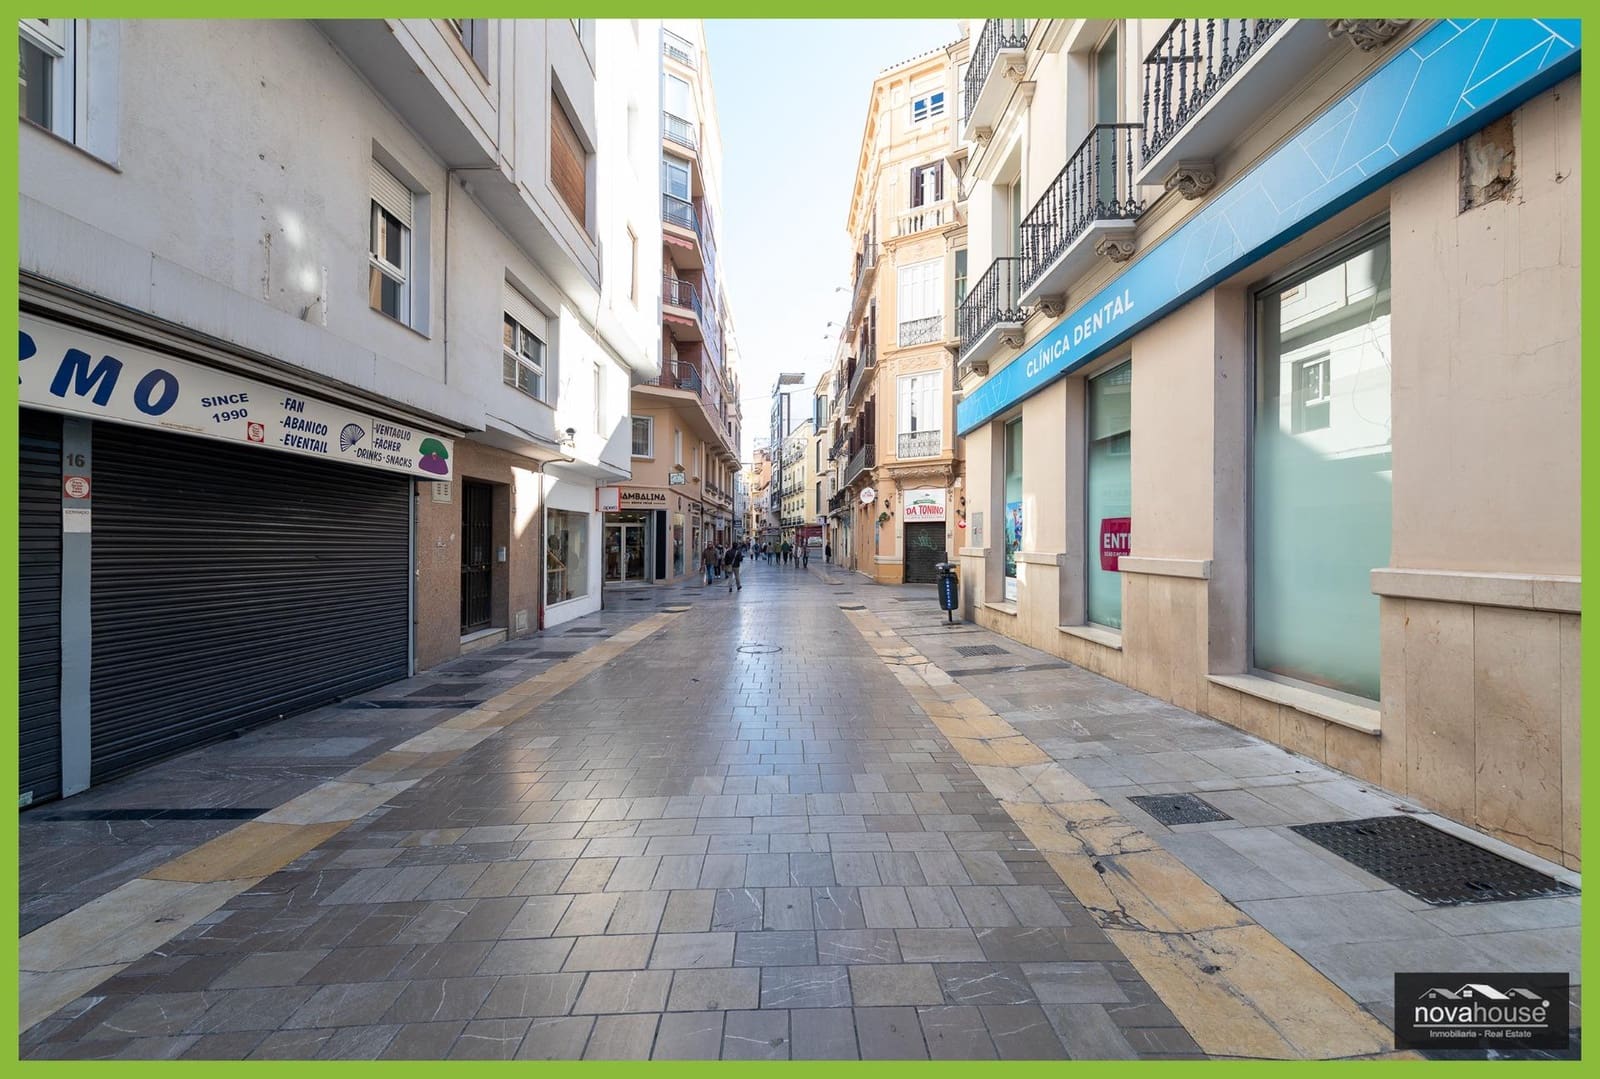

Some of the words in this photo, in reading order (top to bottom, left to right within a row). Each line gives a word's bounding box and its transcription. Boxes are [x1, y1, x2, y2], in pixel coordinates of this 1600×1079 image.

[1026, 335, 1070, 378] CLÍNICA
[1074, 289, 1135, 346] DENTAL
[201, 393, 249, 408] SINCE
[212, 408, 248, 423] 1990
[280, 415, 328, 436] -ABANICO
[66, 453, 85, 468] 16
[906, 506, 917, 515] DA
[918, 505, 944, 515] TONINO
